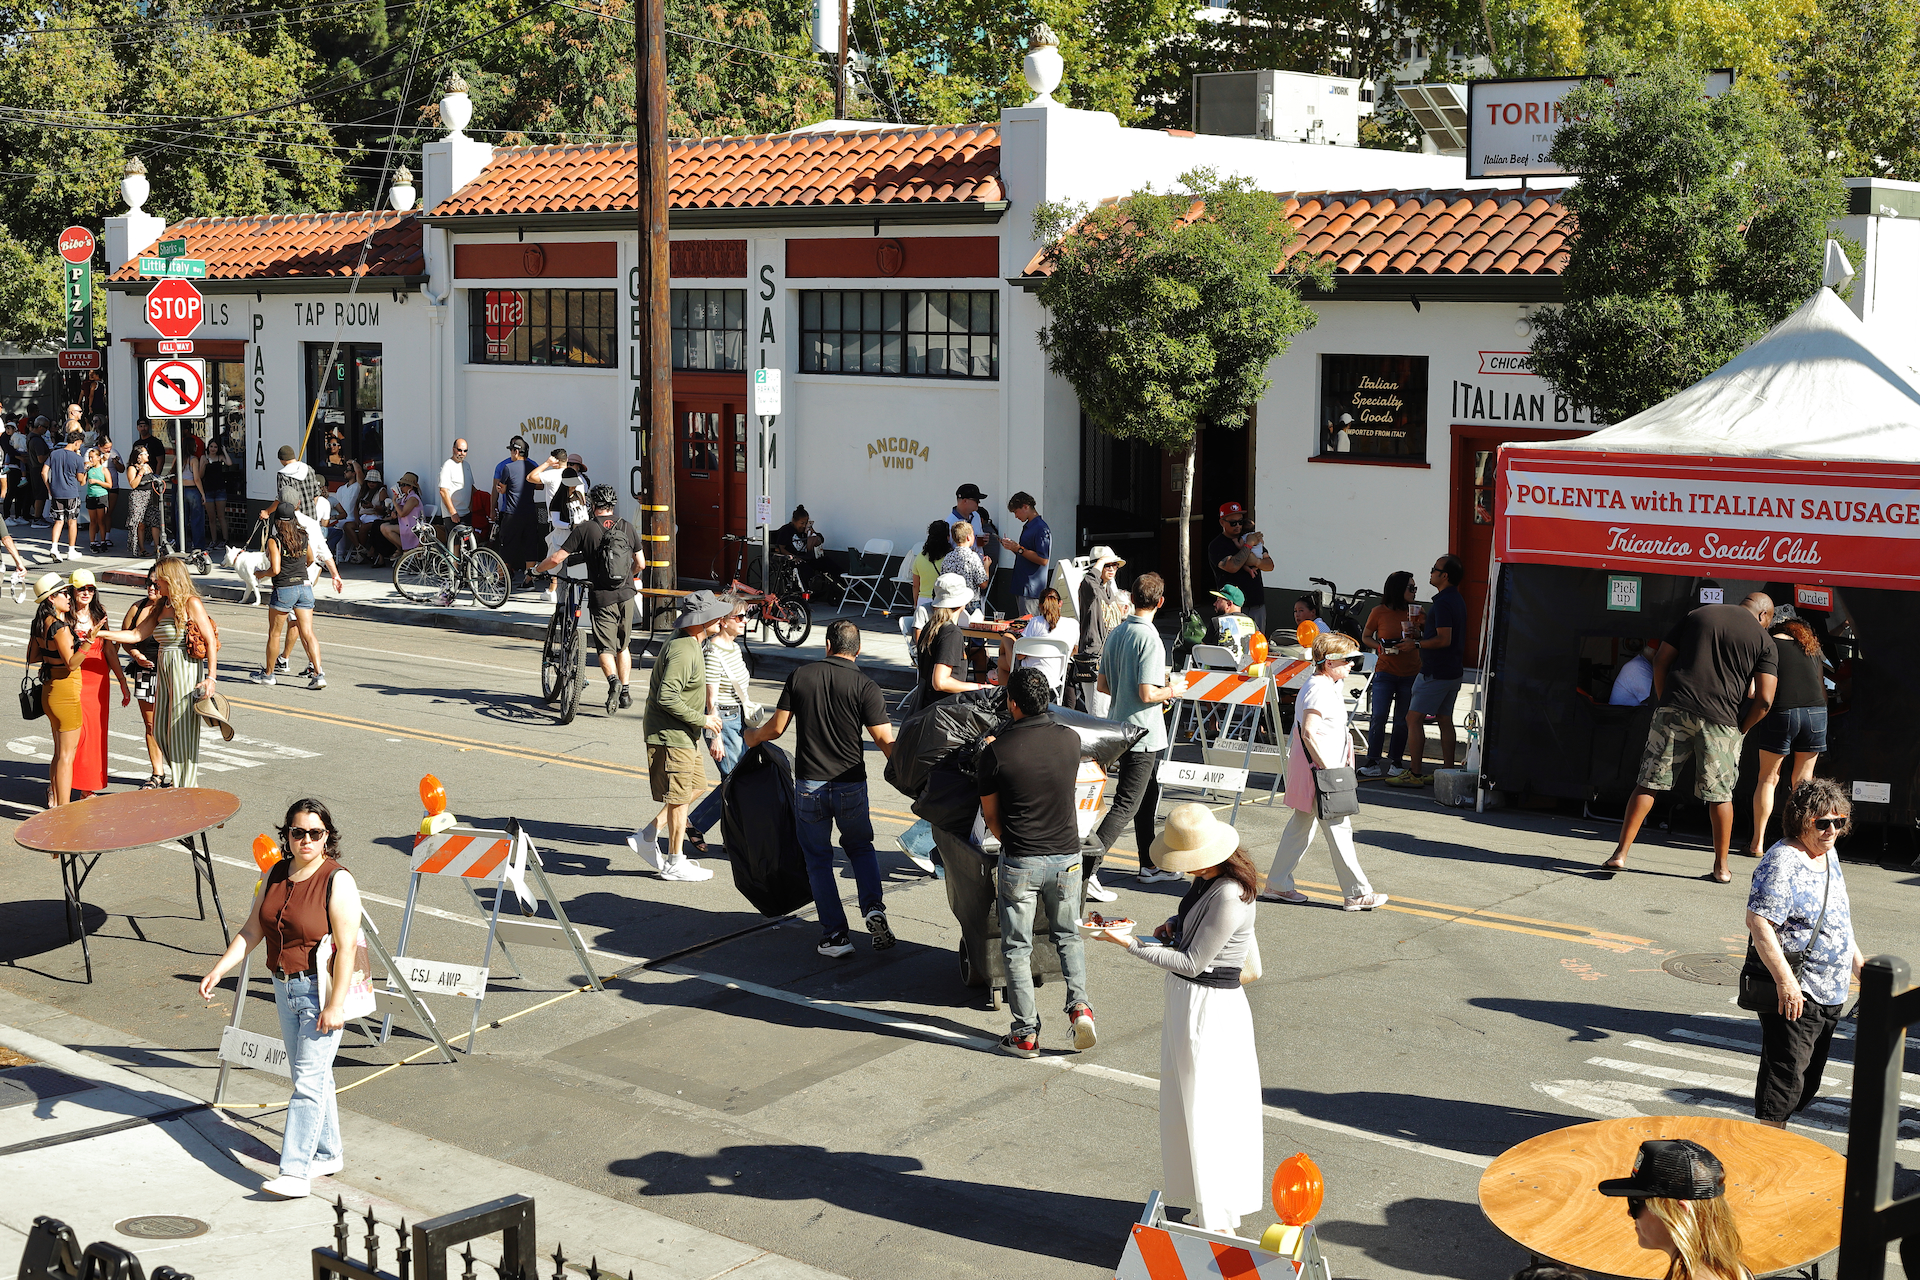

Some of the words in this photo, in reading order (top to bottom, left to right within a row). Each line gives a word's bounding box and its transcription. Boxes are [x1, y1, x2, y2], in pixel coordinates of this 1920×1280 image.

[1334, 86, 1349, 96] YORK
[1484, 155, 1508, 164] Italian
[1510, 154, 1529, 166] Beef
[60, 236, 92, 251] Bibo's
[160, 244, 178, 255] Sharks
[142, 260, 167, 272] Little
[168, 261, 190, 275] Italy
[193, 266, 202, 274] Way
[70, 268, 85, 344] PIZZA
[150, 297, 200, 319] STOP
[295, 303, 325, 326] TAP
[335, 303, 379, 326] ROOM
[176, 343, 190, 351] WAY
[1490, 357, 1533, 370] CHICA
[758, 371, 765, 382] 2
[1358, 375, 1399, 390] Italian
[253, 314, 266, 471] PASTA
[1352, 392, 1403, 411] Specialty
[1453, 380, 1545, 422] ITALIAN
[1360, 408, 1394, 424] Goods
[520, 416, 568, 438] ANCORA
[1391, 430, 1407, 438] ITALY
[532, 433, 557, 445] VINO
[867, 437, 930, 463] ANCORA
[882, 456, 914, 470] VINO
[1517, 484, 1627, 510] POLENTA
[1631, 490, 1683, 513] with
[1688, 493, 1795, 519] ITALIAN
[1800, 499, 1920, 525] SAUSAGE
[1607, 526, 1692, 556] Tricarico
[1699, 532, 1767, 562] Social
[1772, 537, 1822, 565] Club
[1613, 582, 1636, 594] Pick
[1616, 594, 1631, 603] up
[1703, 591, 1720, 601] $12
[1799, 591, 1828, 606] Order
[1178, 769, 1196, 781] CSJ
[1203, 771, 1225, 783] AWP
[411, 968, 430, 983] CSJ
[438, 971, 462, 987] AWP
[240, 1041, 259, 1059] CSJ
[264, 1049, 287, 1066] AWP
